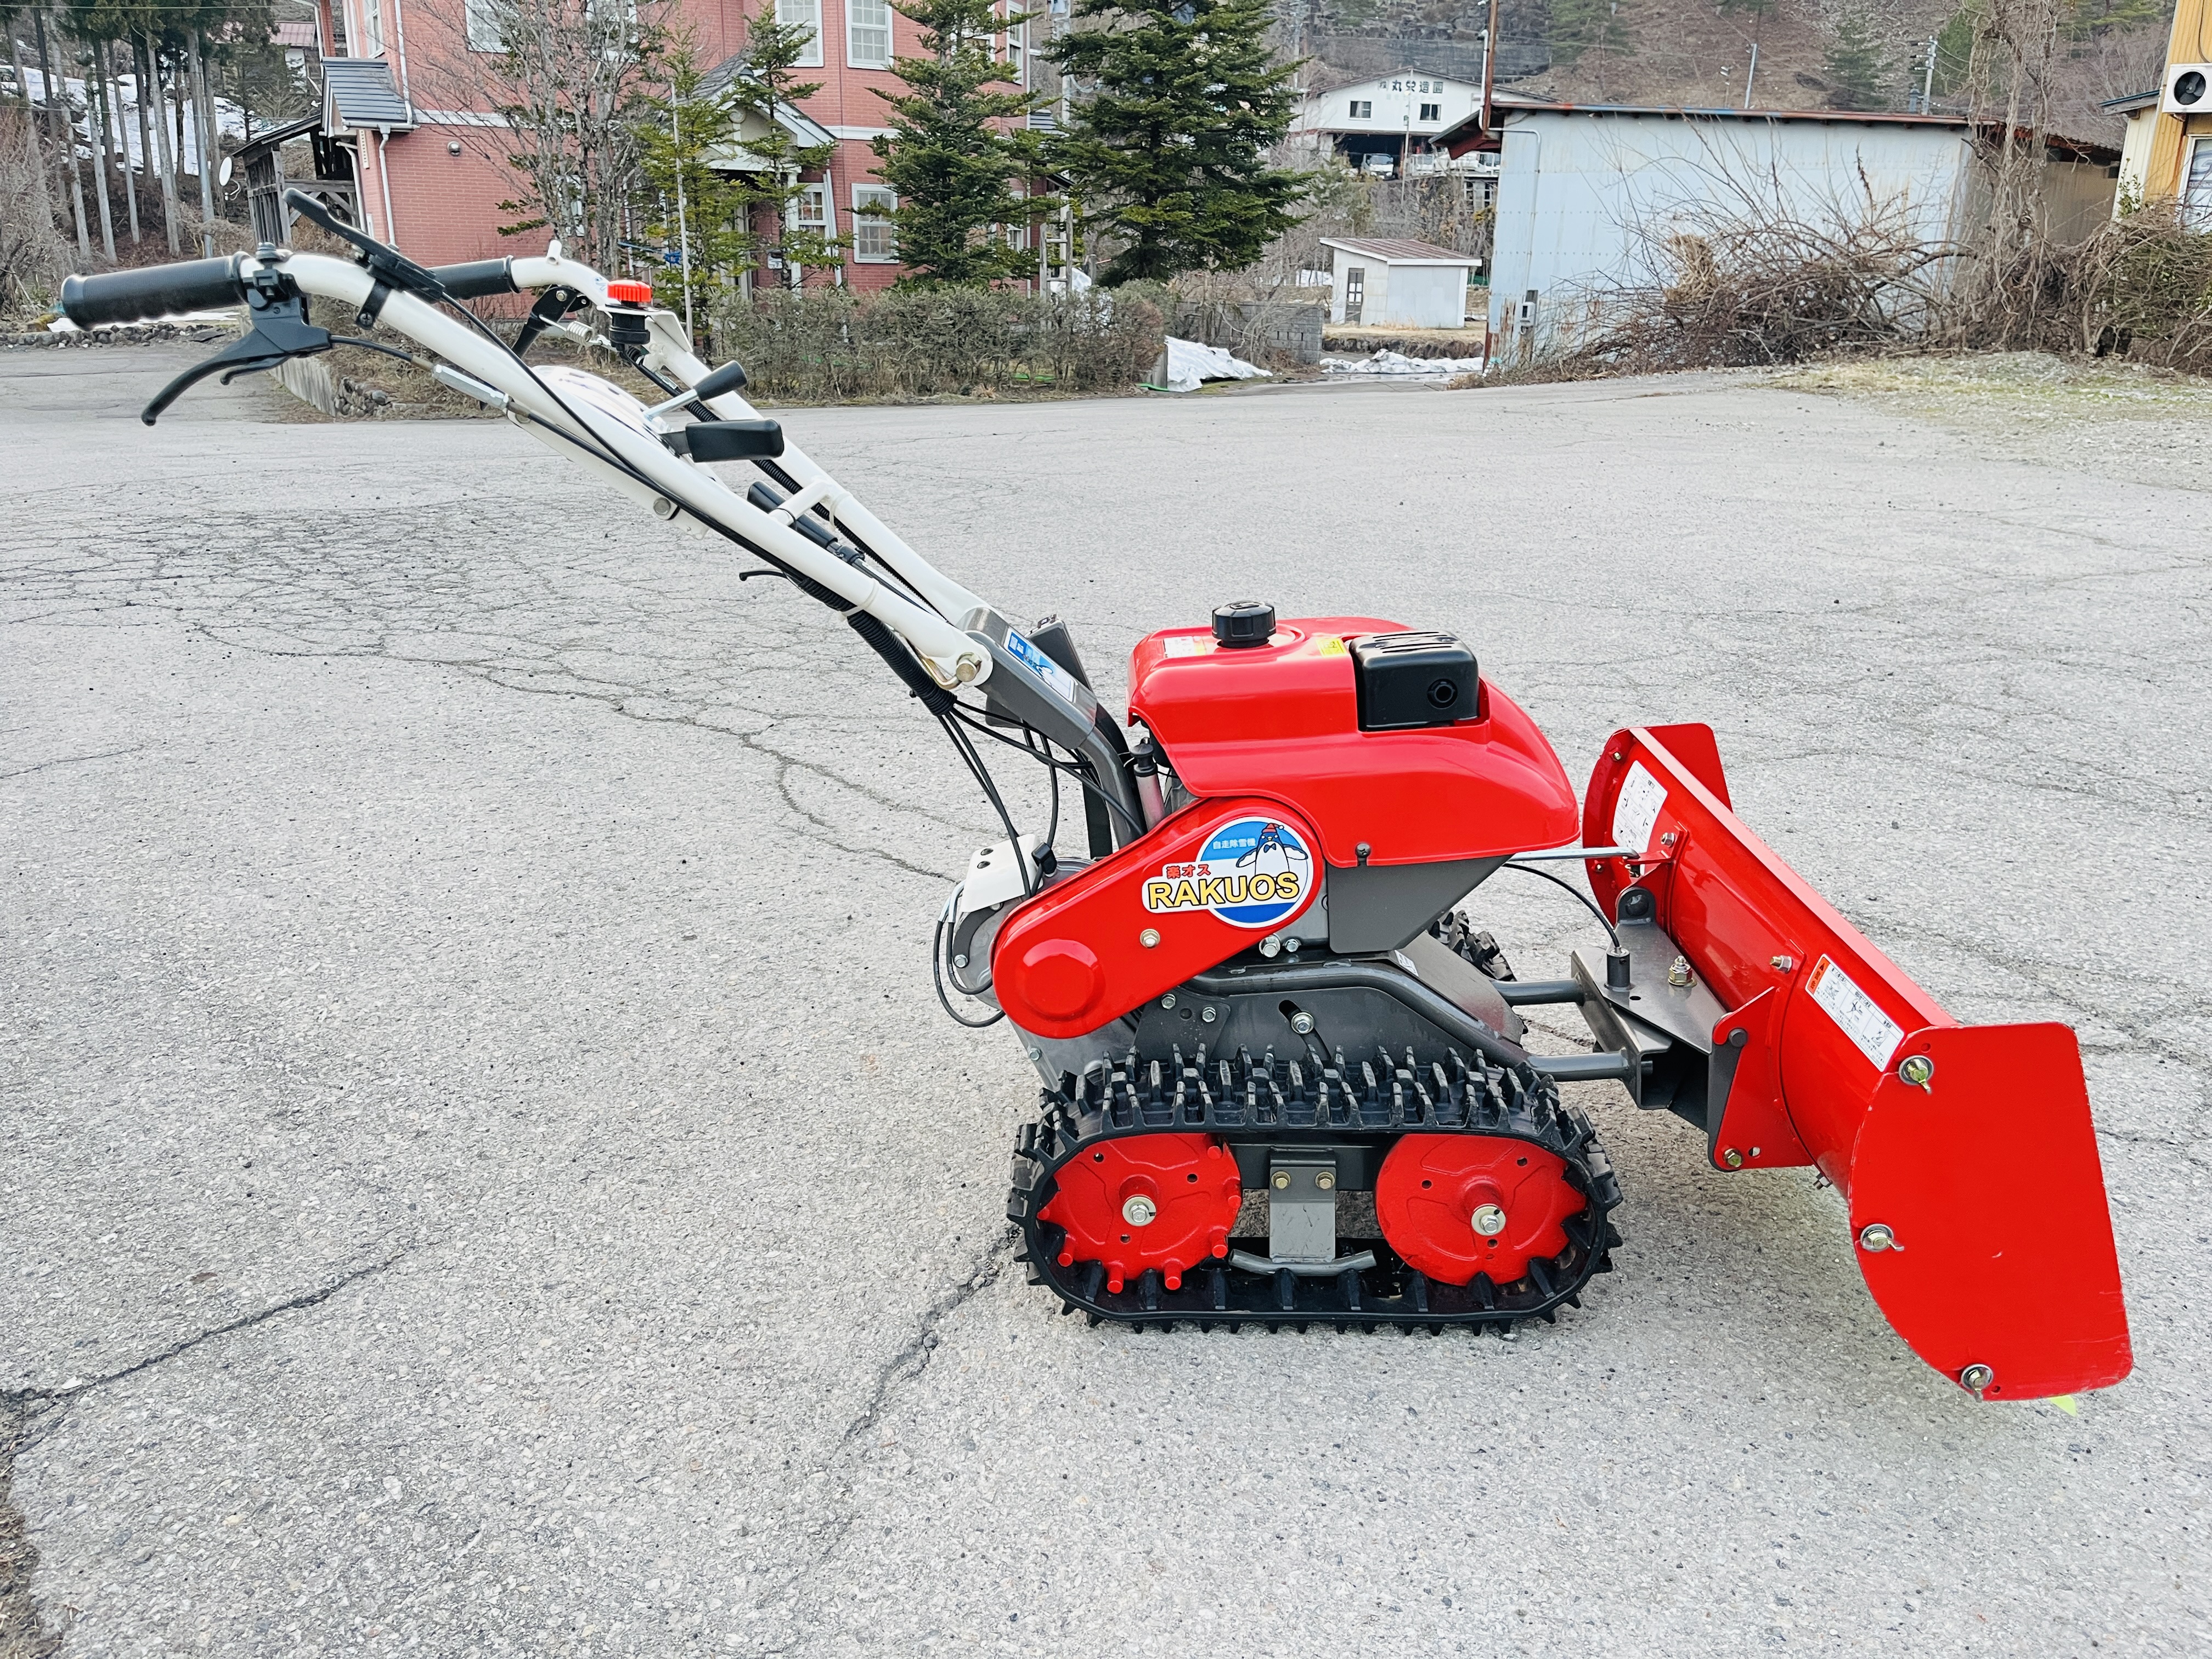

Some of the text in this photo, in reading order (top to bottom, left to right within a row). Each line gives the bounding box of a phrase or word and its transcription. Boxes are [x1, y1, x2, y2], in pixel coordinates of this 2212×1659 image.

[1166, 864, 1211, 879] 楽オス
[1148, 872, 1300, 909] RAKUOS
